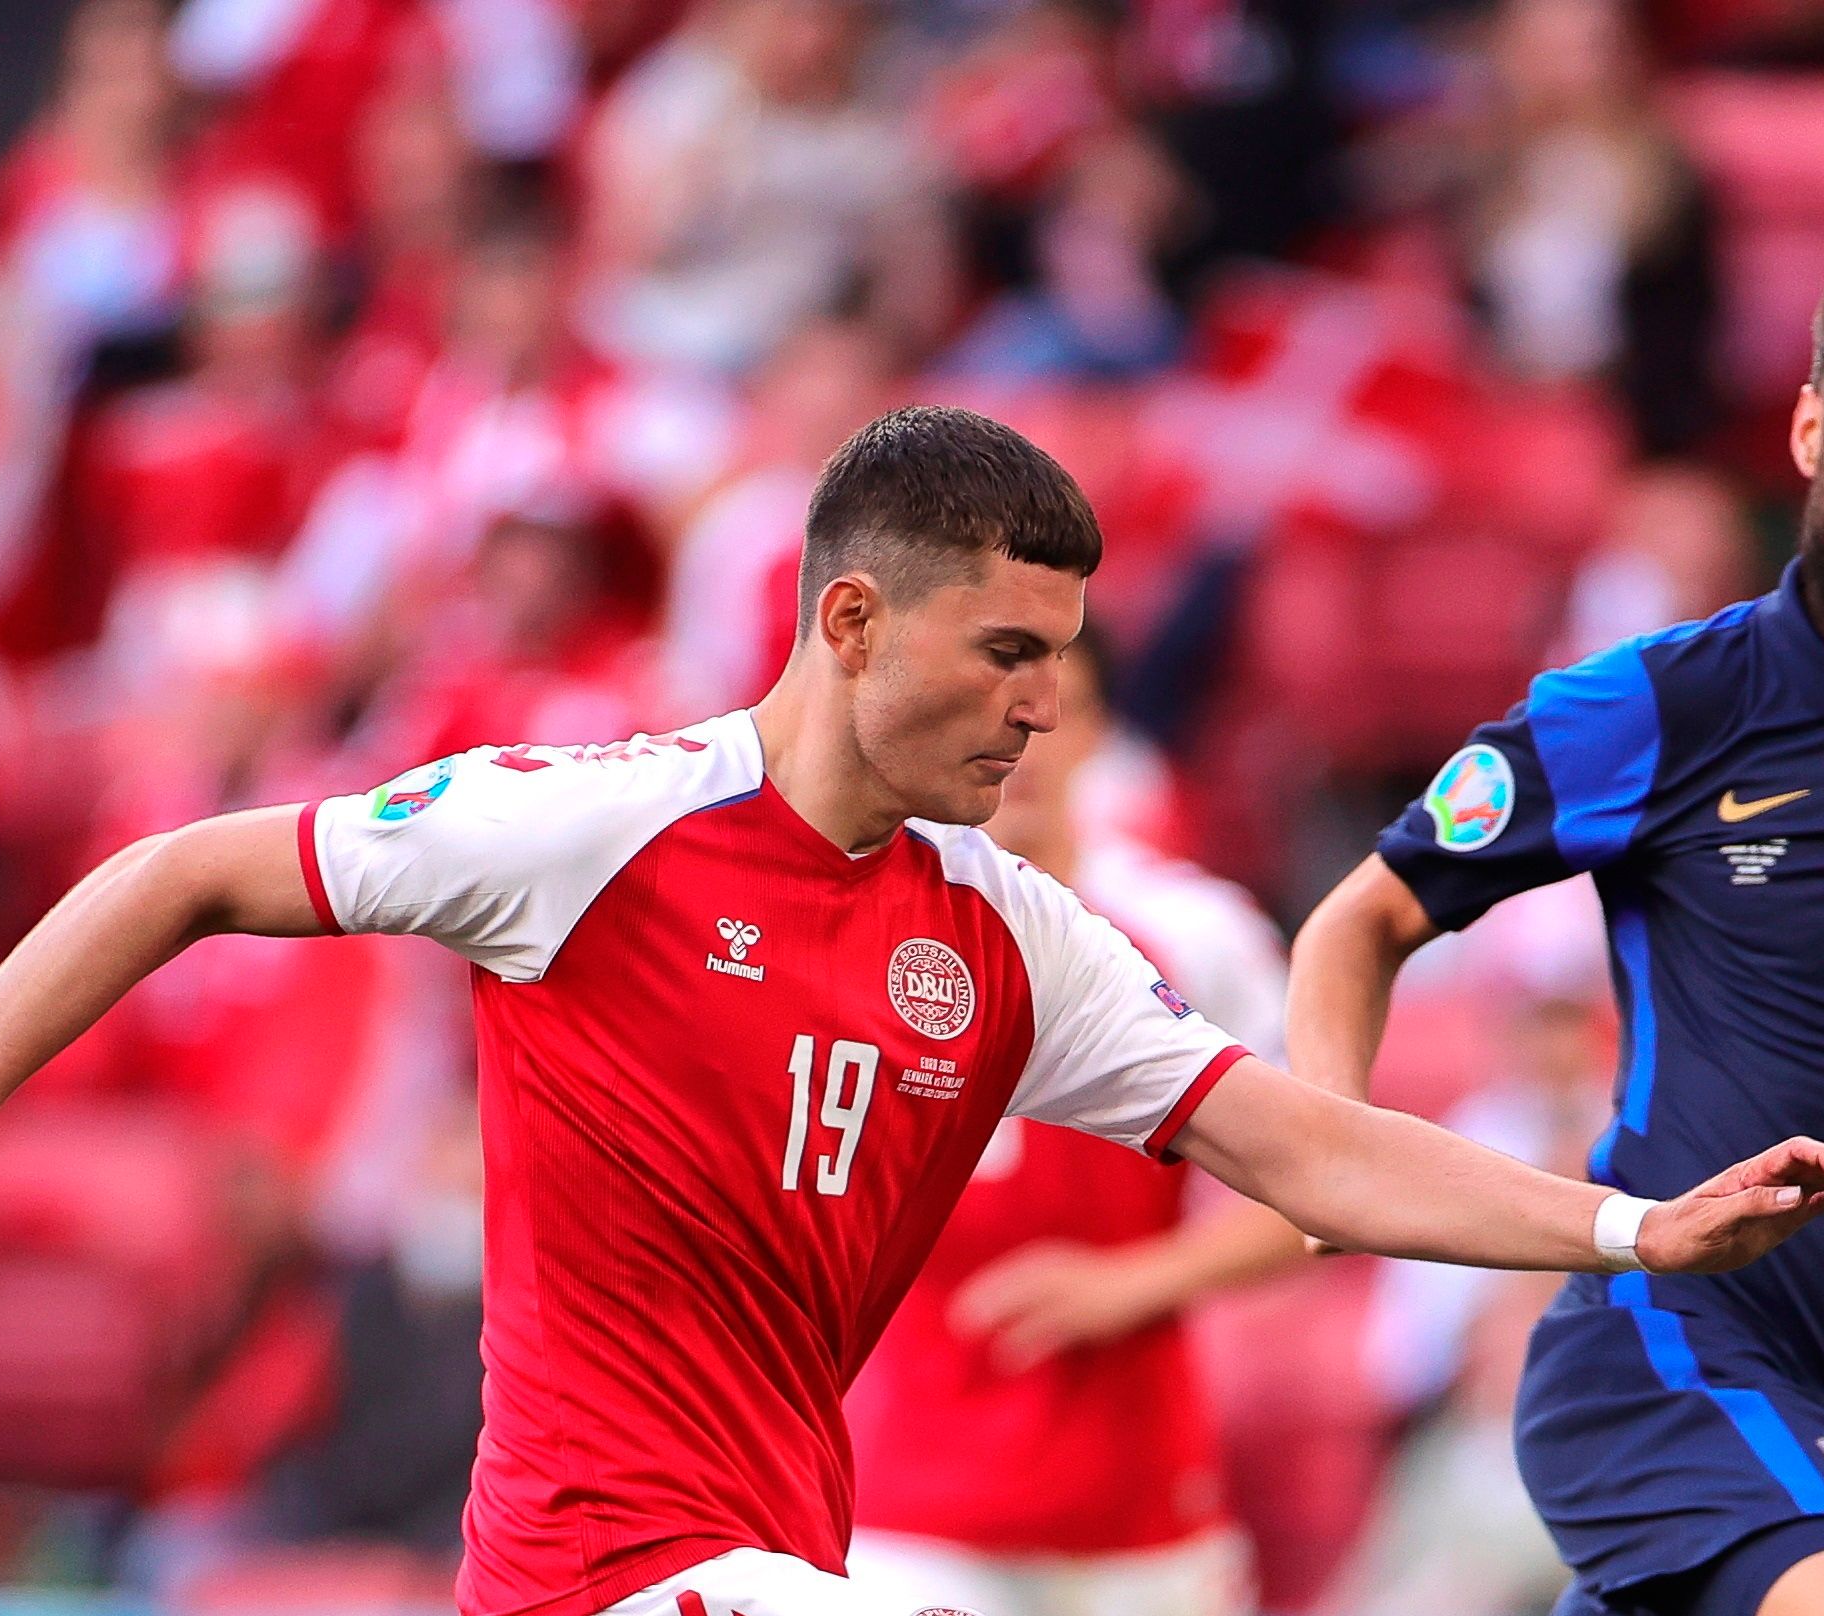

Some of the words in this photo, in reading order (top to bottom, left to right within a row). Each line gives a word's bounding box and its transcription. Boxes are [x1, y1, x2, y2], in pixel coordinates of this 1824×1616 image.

[705, 952, 765, 982] hummel
[904, 970, 955, 1005] DBU
[781, 1033, 881, 1196] 19
